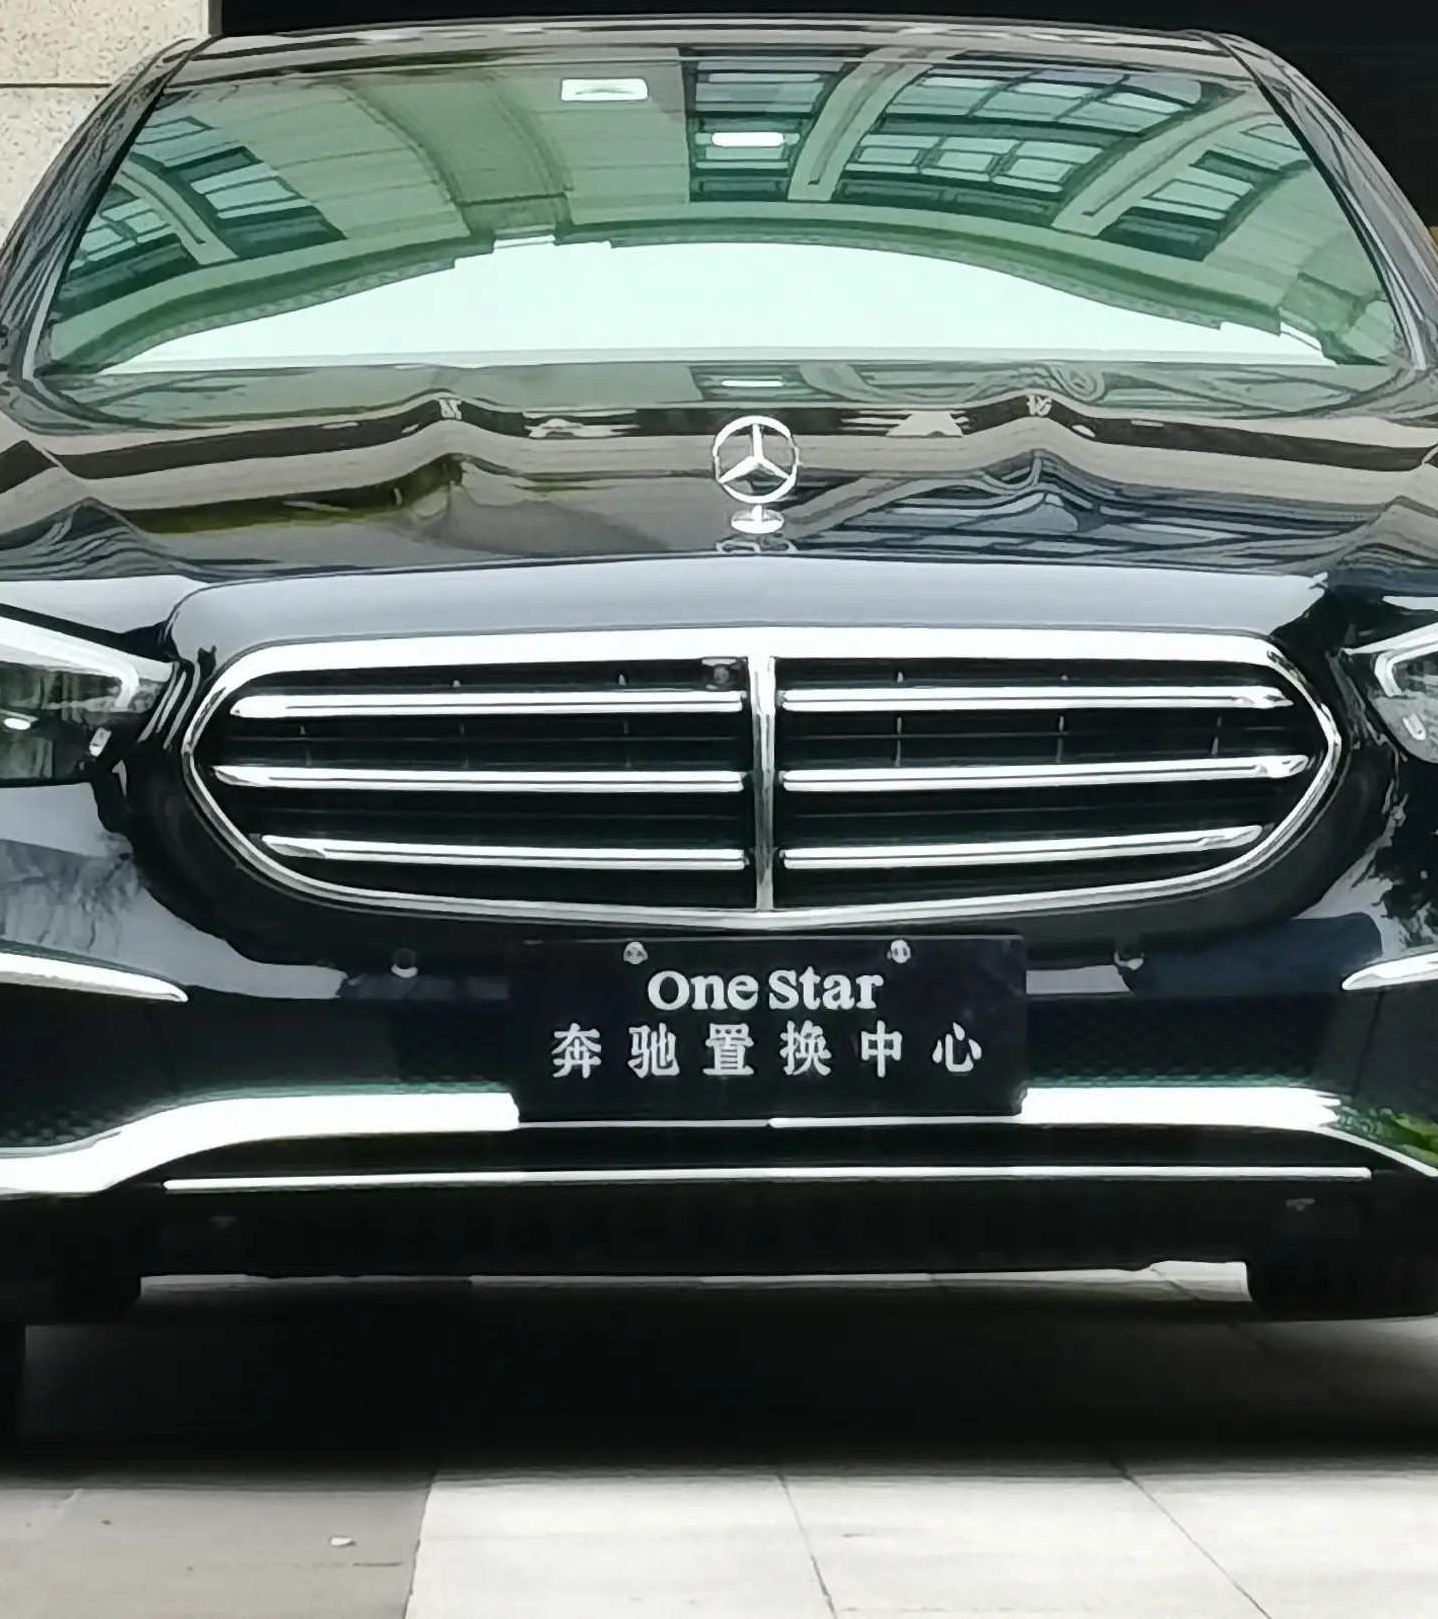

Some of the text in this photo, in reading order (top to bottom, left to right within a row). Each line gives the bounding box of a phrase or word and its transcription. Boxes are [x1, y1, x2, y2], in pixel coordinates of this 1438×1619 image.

[550, 1020, 982, 1079] 奔驰置换中心
